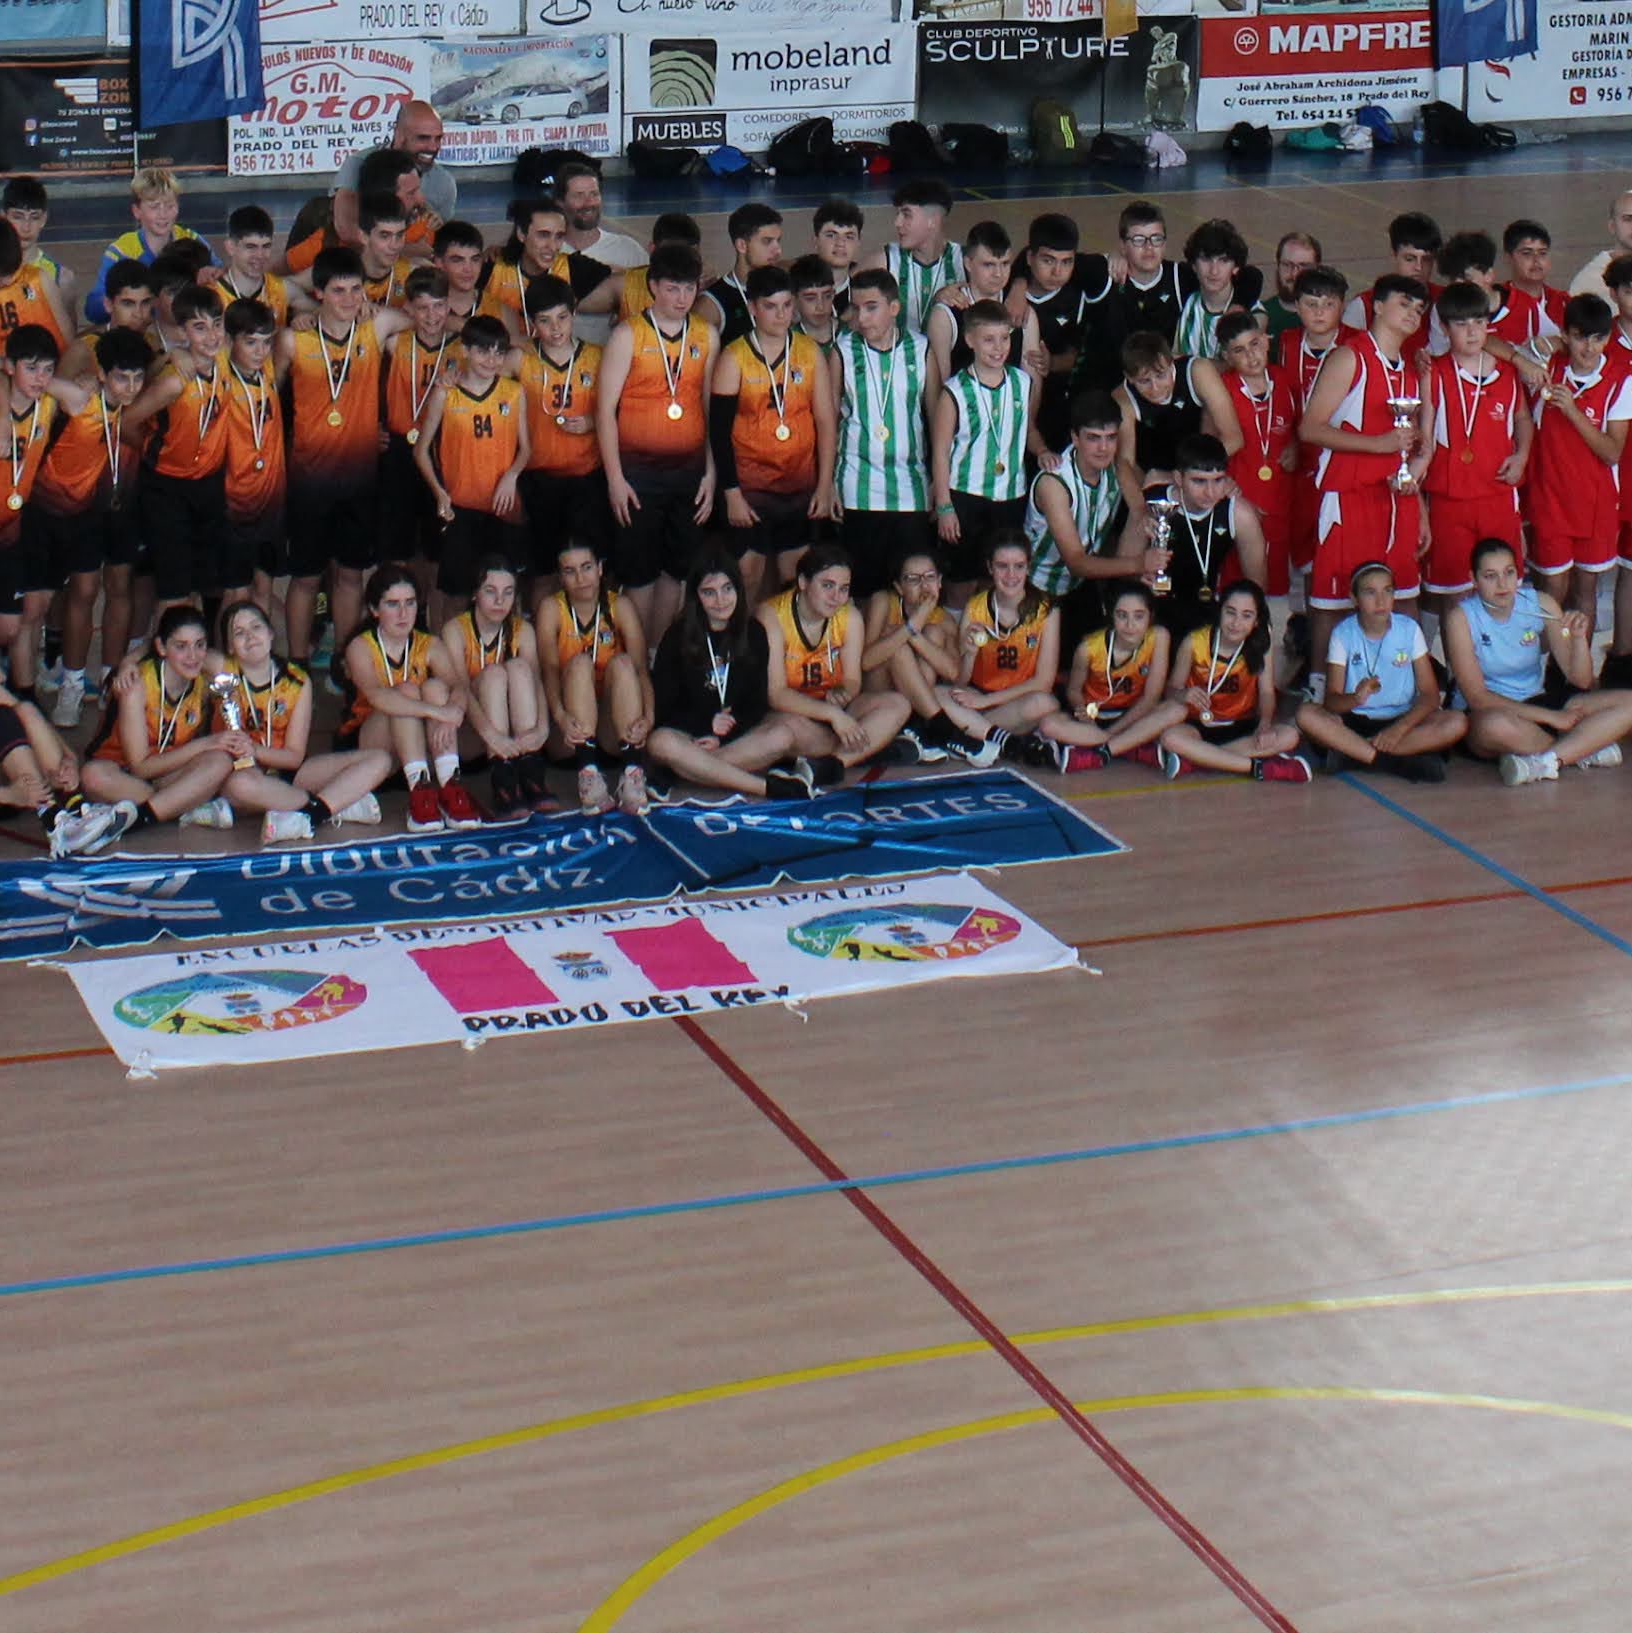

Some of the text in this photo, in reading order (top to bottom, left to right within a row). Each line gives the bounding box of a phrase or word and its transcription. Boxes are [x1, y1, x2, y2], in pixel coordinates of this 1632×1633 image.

[360, 4, 445, 26] PRADO DEL REY
[1549, 12, 1608, 29] GESTORIA
[926, 26, 1039, 40] CLUB DEPORTIVO
[1269, 20, 1432, 54] MAPFRE
[1589, 31, 1631, 46] MARIN
[731, 37, 892, 72] mobeland
[926, 35, 1130, 63] SCULPTURE
[1572, 45, 1624, 63] GESTORÍA
[290, 72, 347, 95] G.M.
[769, 73, 852, 94] inprasur
[1236, 75, 1418, 92] José Abraham Archidona Jiménez
[1562, 66, 1618, 81] EMPRESAS
[1597, 86, 1624, 102] 956
[636, 120, 723, 140] MUEBLES
[234, 151, 314, 171] 956 72 32 14
[473, 414, 493, 440] 84
[260, 865, 606, 915] de Cádiz
